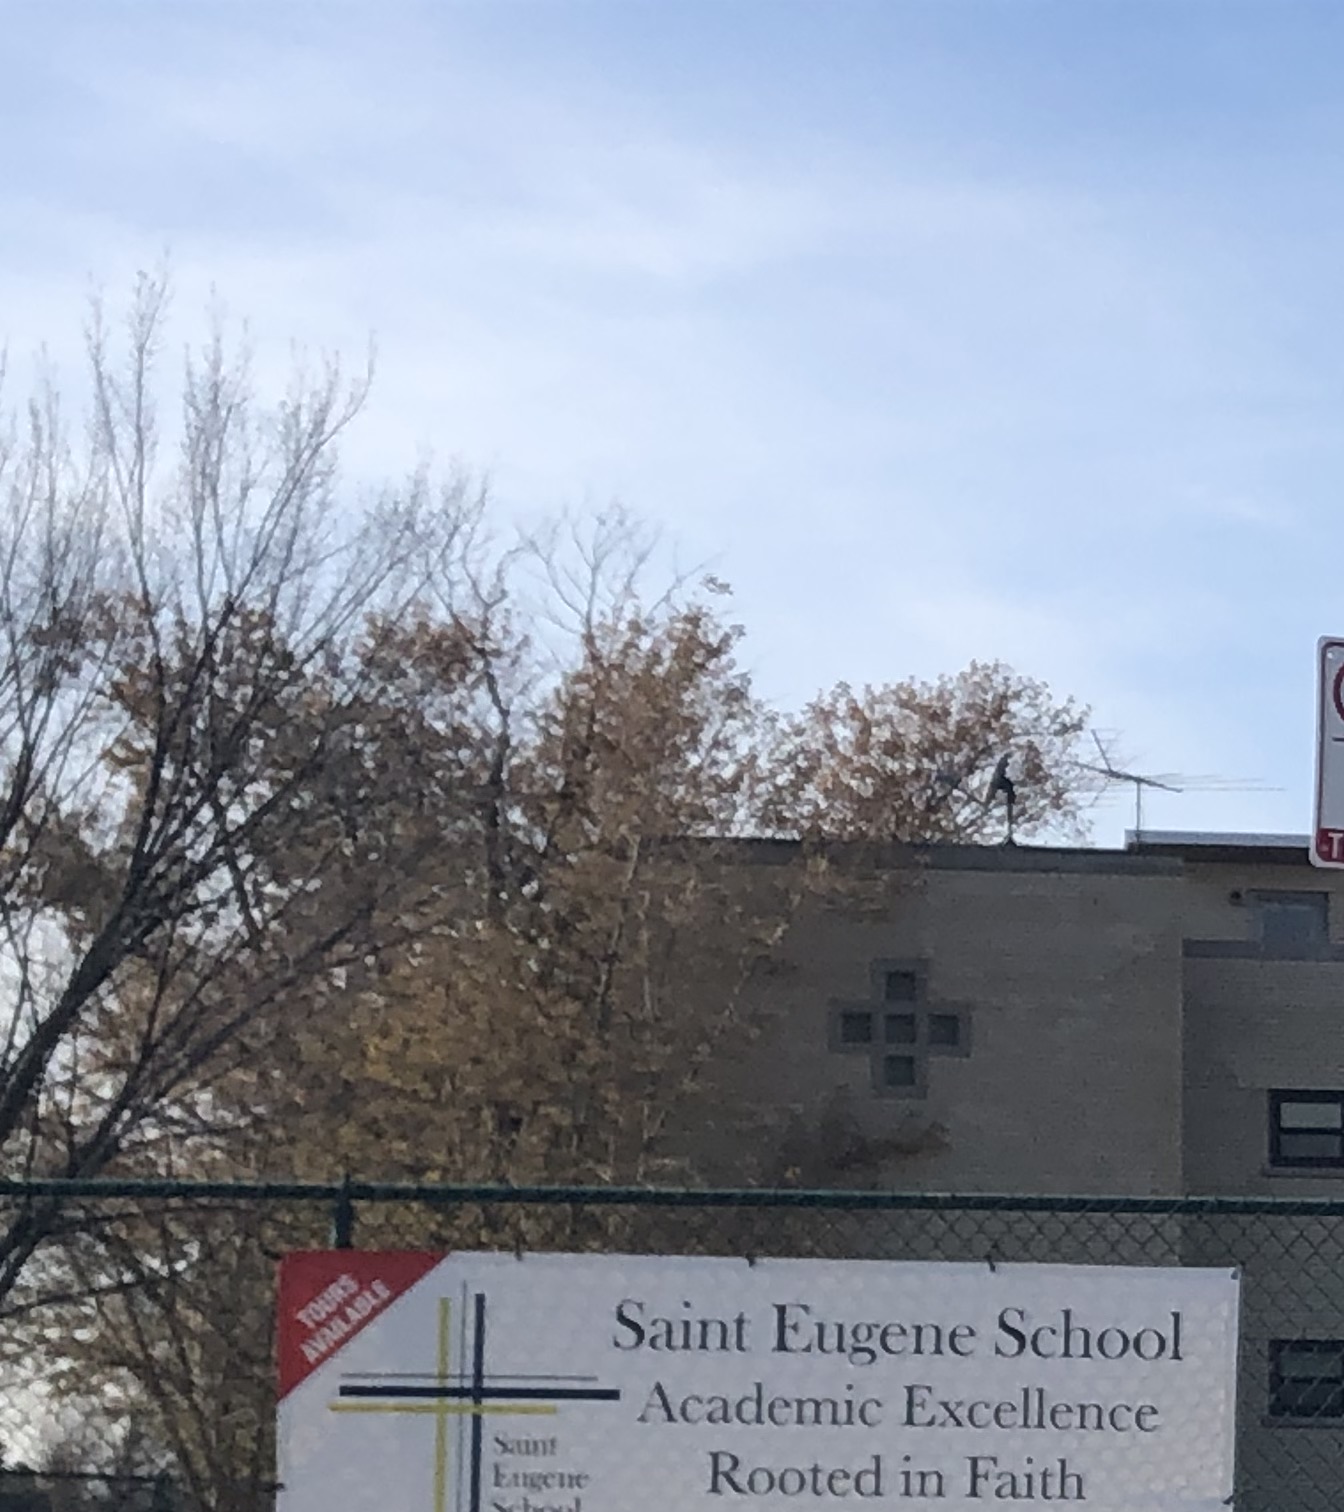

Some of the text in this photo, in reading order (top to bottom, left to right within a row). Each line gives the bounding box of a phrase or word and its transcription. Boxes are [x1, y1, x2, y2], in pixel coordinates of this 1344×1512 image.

[297, 1274, 359, 1329] TOURS
[300, 1280, 391, 1364] AVAILABLE
[612, 1300, 1184, 1366] Saint Eugene School
[636, 1381, 1161, 1433] Academic Excellence
[493, 1431, 557, 1456] Saint
[493, 1462, 590, 1493] Eugene
[706, 1450, 1087, 1501] Rooted in Faith
